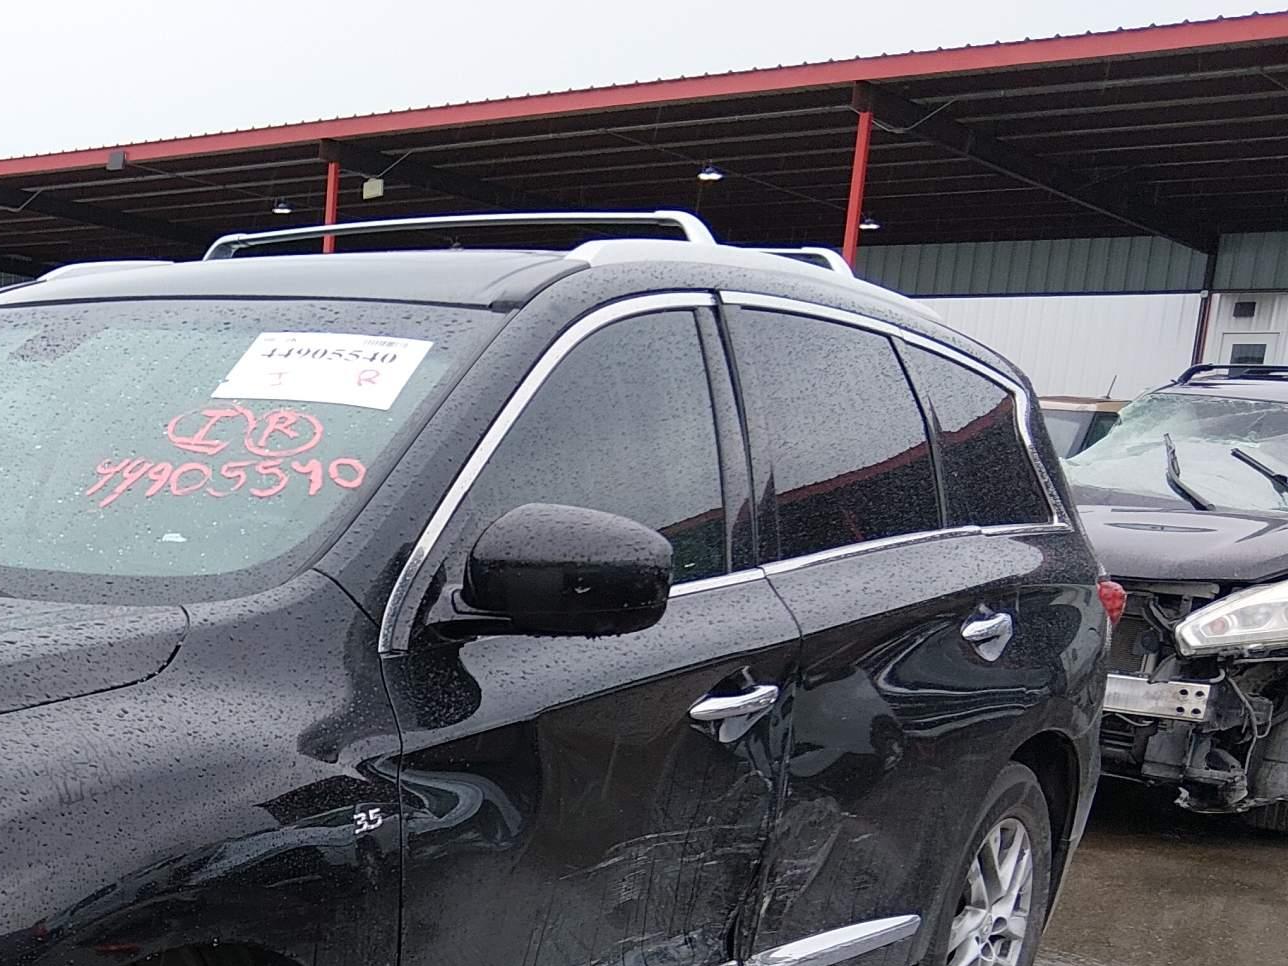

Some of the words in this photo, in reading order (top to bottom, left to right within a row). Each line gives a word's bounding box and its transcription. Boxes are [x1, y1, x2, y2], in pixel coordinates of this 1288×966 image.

[261, 347, 397, 364] 44905540
[357, 369, 380, 386] R
[353, 807, 383, 835] 35
